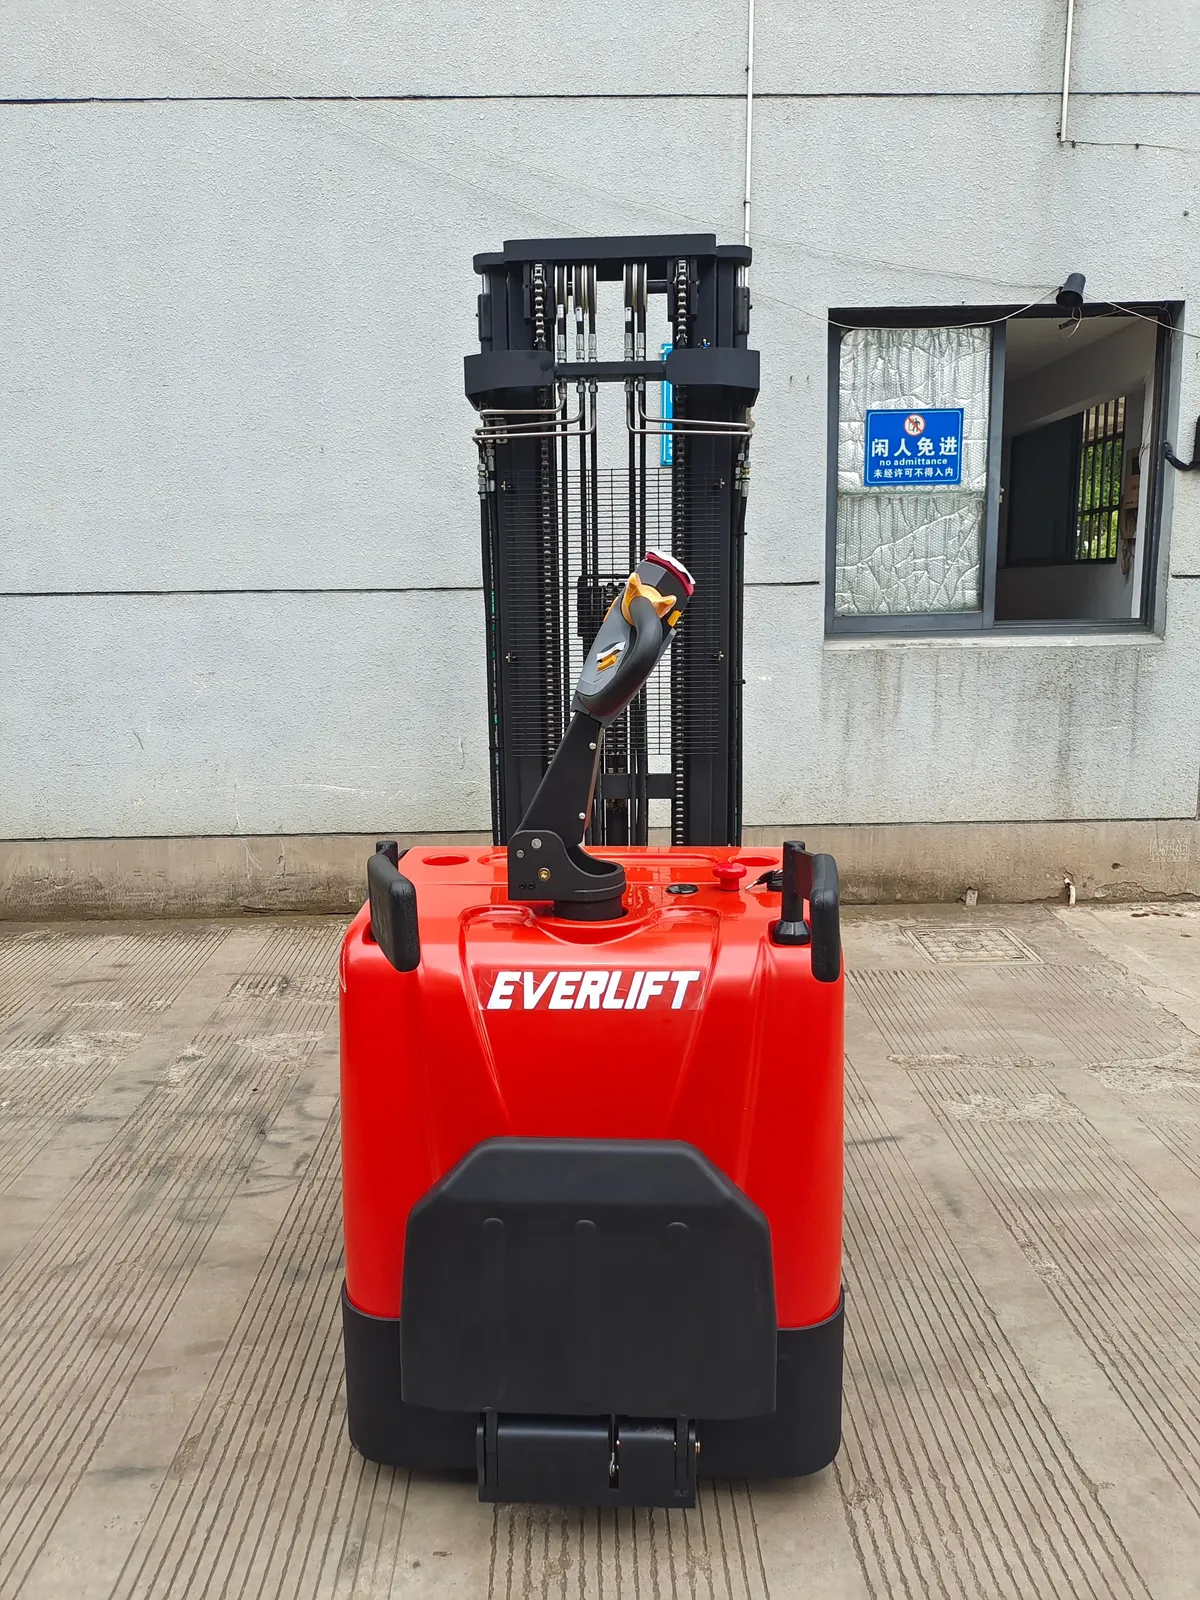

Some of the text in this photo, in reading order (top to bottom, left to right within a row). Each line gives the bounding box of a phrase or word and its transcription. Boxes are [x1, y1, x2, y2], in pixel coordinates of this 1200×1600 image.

[871, 436, 957, 457] 闲人免进
[893, 457, 948, 466] admittance
[873, 467, 954, 479] 未经许可不得入内
[486, 970, 701, 1010] EVERLIFT
